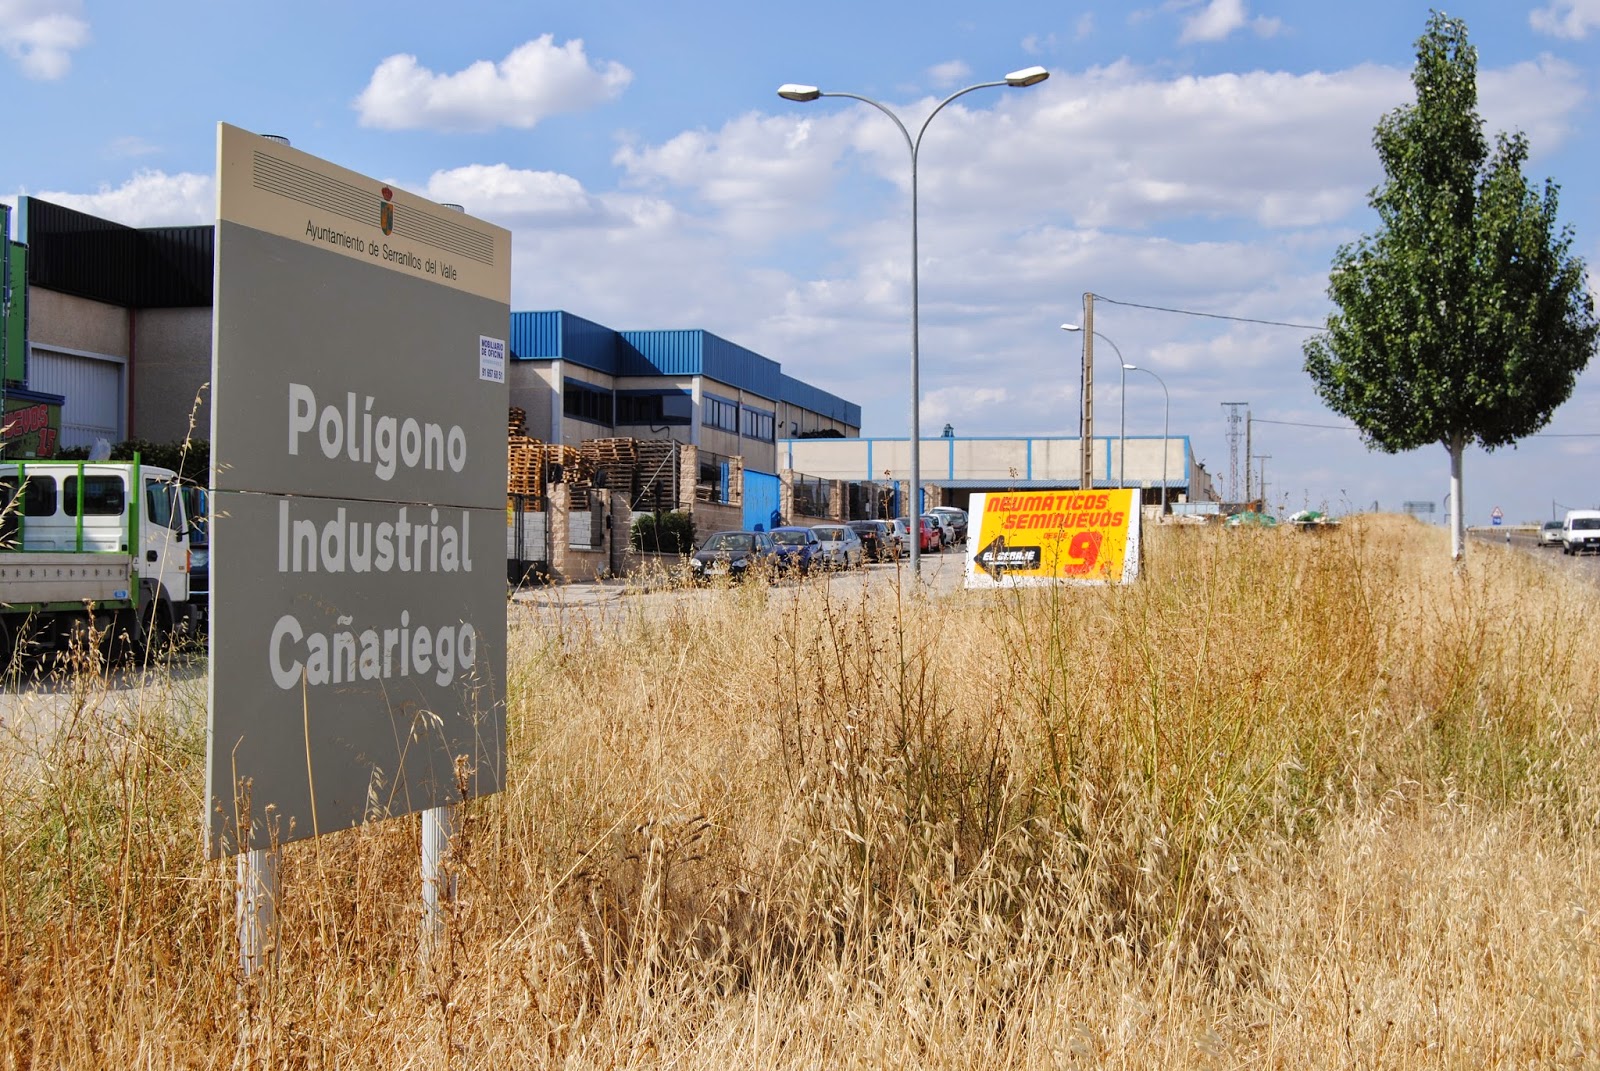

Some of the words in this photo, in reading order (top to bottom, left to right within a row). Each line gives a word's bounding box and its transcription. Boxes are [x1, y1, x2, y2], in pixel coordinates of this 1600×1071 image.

[305, 219, 365, 253] Ayuntamiento
[368, 240, 379, 257] de
[382, 243, 422, 270] Serranillos
[424, 258, 437, 275] del
[440, 261, 457, 281] Valle
[481, 339, 504, 352] MOBILIARIO
[481, 347, 487, 356] DE
[487, 349, 504, 360] OFICINA
[4, 404, 49, 439] UEVOS
[288, 382, 467, 481] Polígono
[278, 499, 472, 574] Industrial
[1003, 511, 1125, 530] SEMINUEVOS
[269, 609, 477, 690] Cañariego
